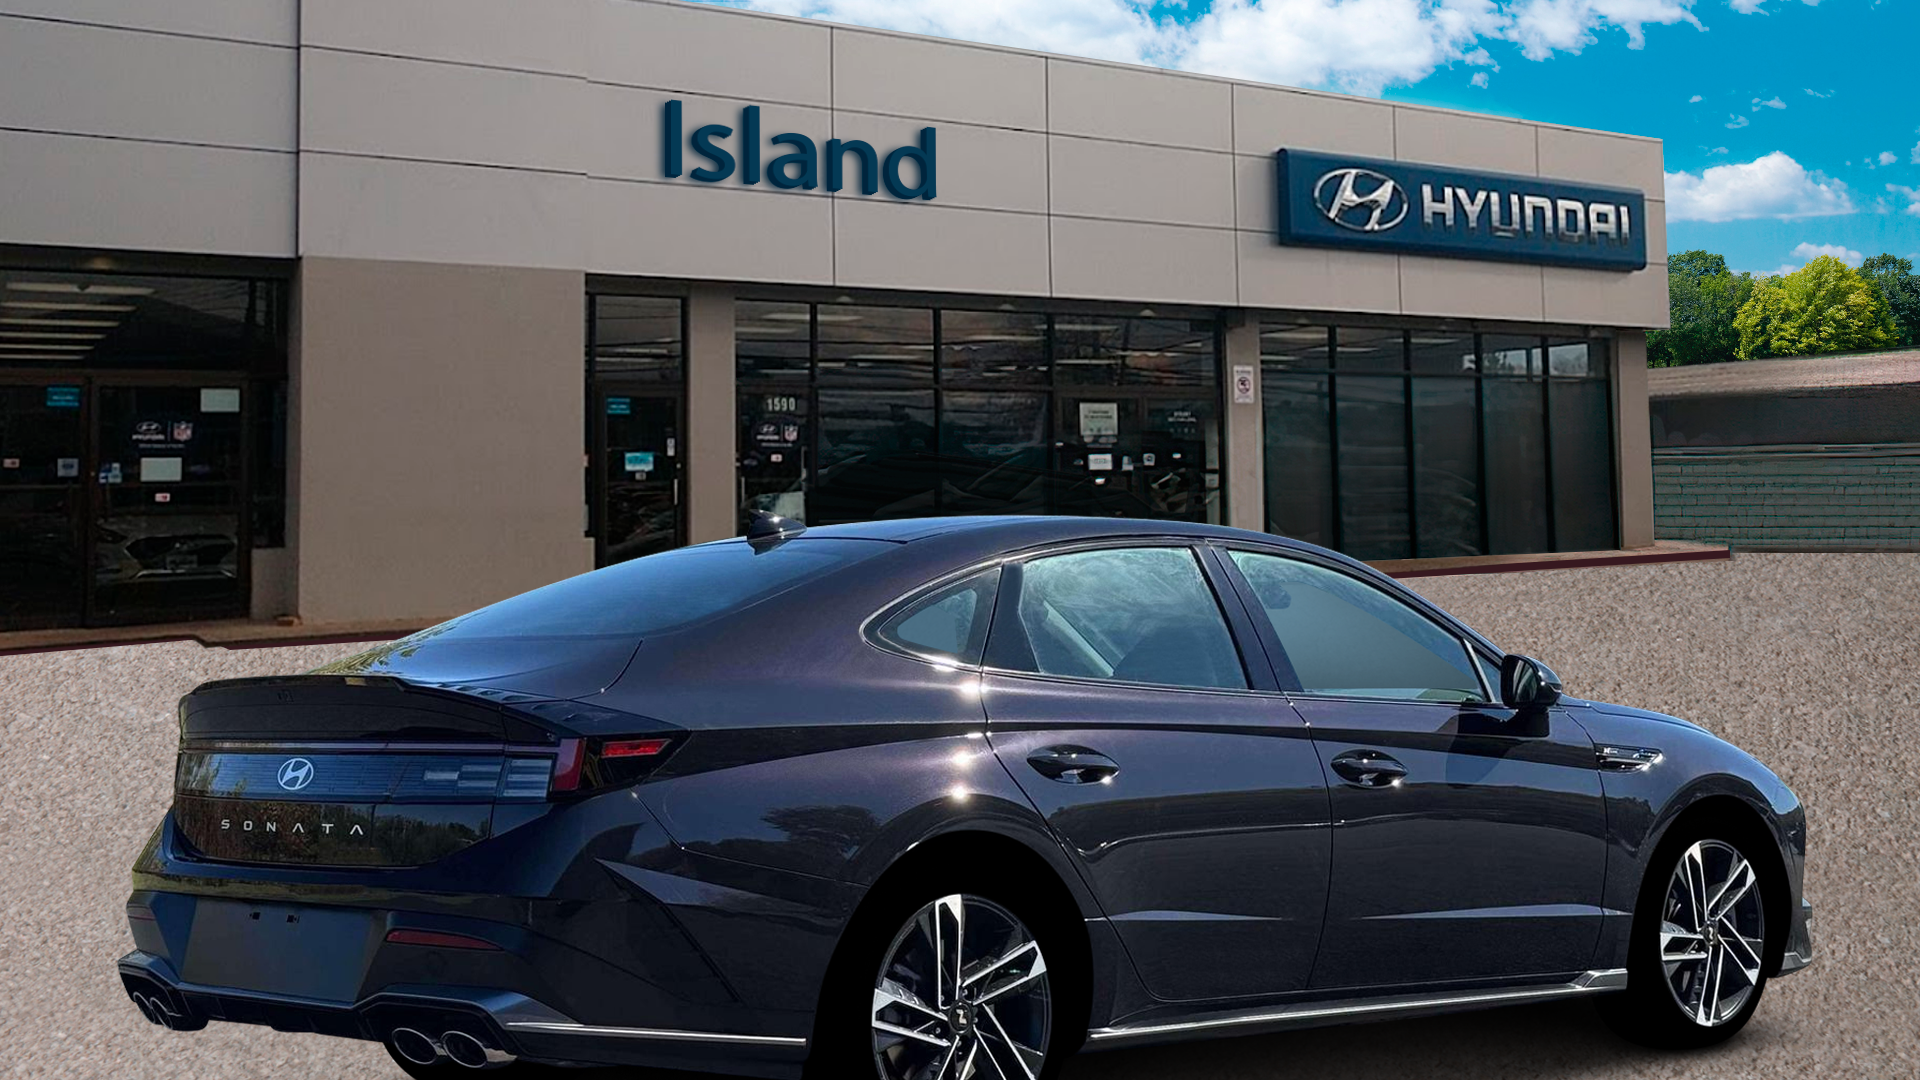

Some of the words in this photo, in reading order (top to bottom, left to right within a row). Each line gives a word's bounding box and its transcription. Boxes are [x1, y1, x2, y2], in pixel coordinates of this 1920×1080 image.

[664, 99, 937, 201] Island
[1421, 183, 1630, 244] HYUNDAI
[767, 396, 796, 411] 1590
[221, 819, 364, 835] SONATA
